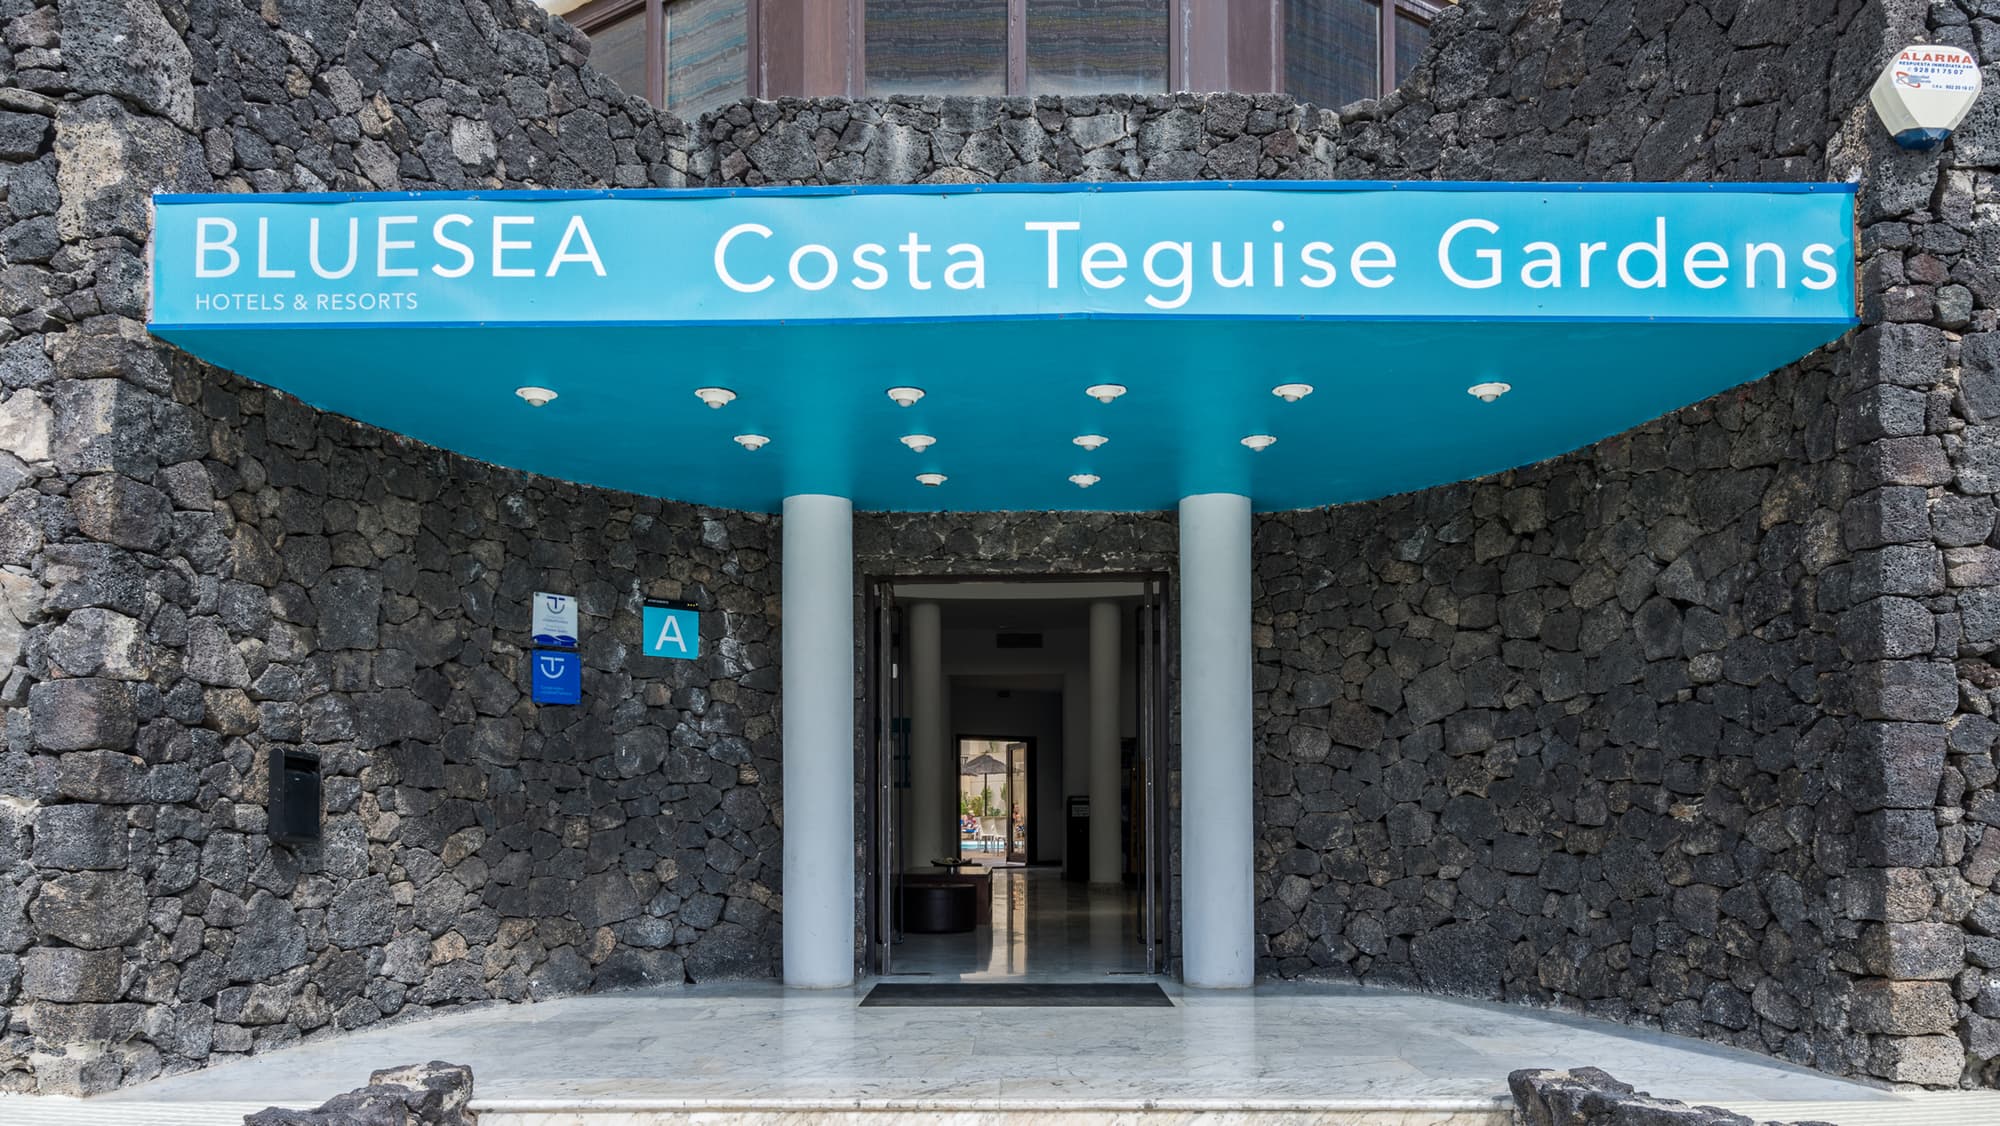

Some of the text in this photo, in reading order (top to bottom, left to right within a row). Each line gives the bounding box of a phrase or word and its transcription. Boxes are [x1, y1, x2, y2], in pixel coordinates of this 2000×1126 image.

[1900, 52, 1972, 64] ALARMA
[195, 213, 607, 280] BLUESEA
[714, 216, 1838, 310] Costa Teguise Gardens
[195, 292, 419, 311] HOTELS & RESORTS
[655, 615, 687, 653] A
